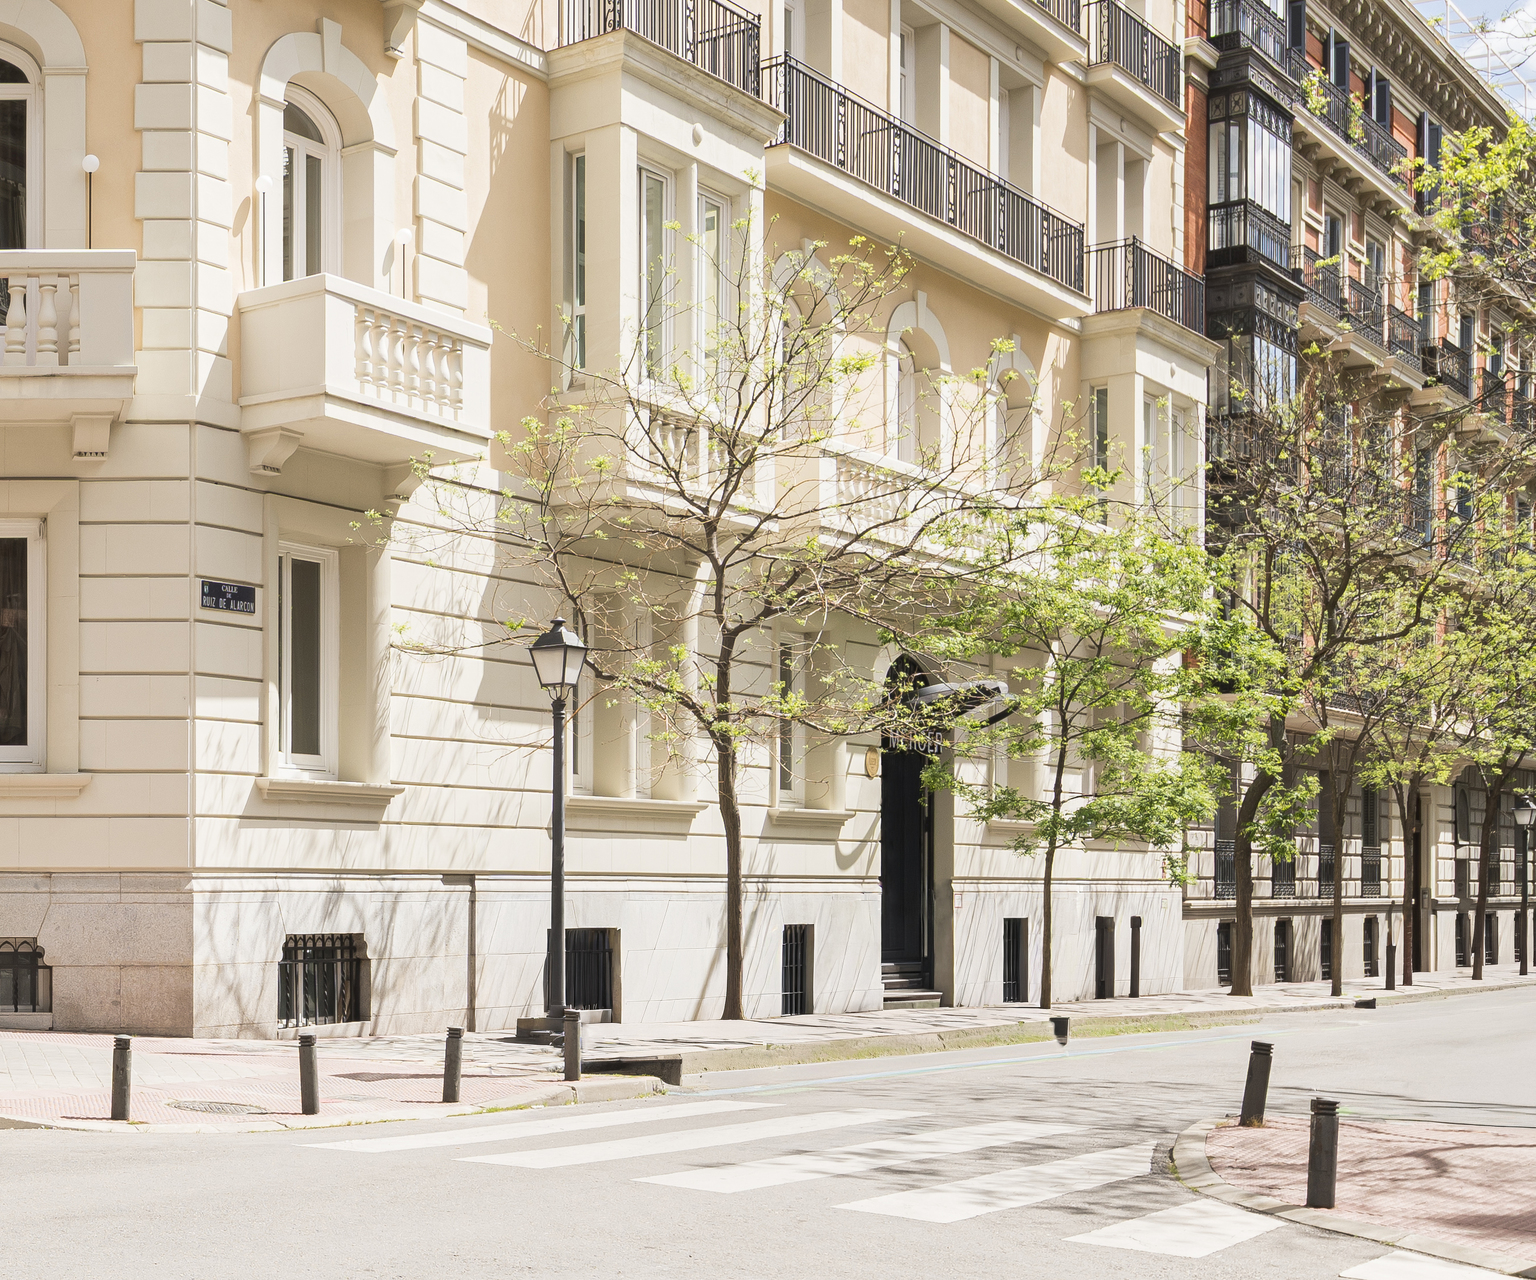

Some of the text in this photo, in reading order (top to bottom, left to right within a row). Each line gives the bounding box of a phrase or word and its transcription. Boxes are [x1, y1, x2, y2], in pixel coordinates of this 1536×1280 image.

[221, 585, 238, 593] CALLE
[203, 596, 216, 607] RUIZ
[219, 598, 227, 609] DE
